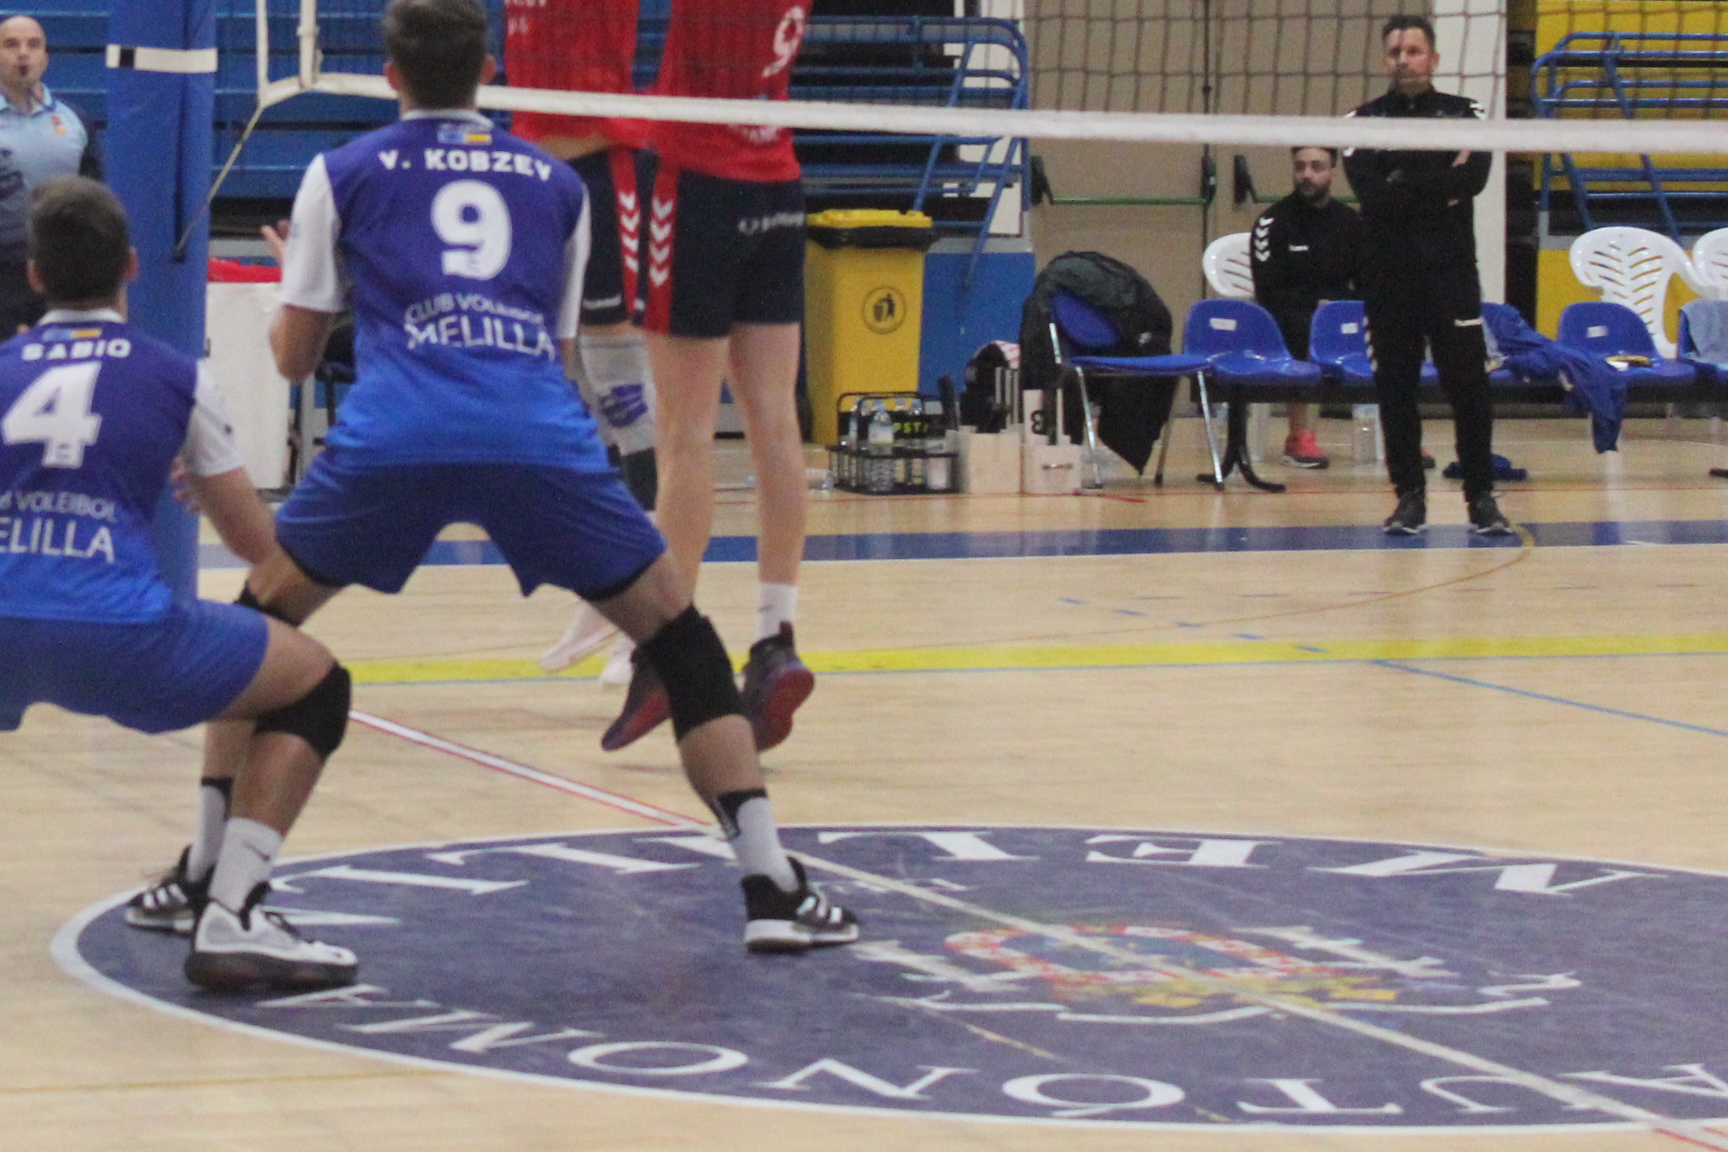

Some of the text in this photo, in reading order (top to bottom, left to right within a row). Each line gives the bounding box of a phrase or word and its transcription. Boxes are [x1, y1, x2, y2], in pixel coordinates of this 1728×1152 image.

[762, 6, 804, 78] 9
[377, 149, 552, 182] V. KOBZEV
[431, 180, 513, 282] 9
[21, 338, 133, 363] SABIO
[404, 313, 557, 363] MELILLA
[0, 361, 103, 469] 4
